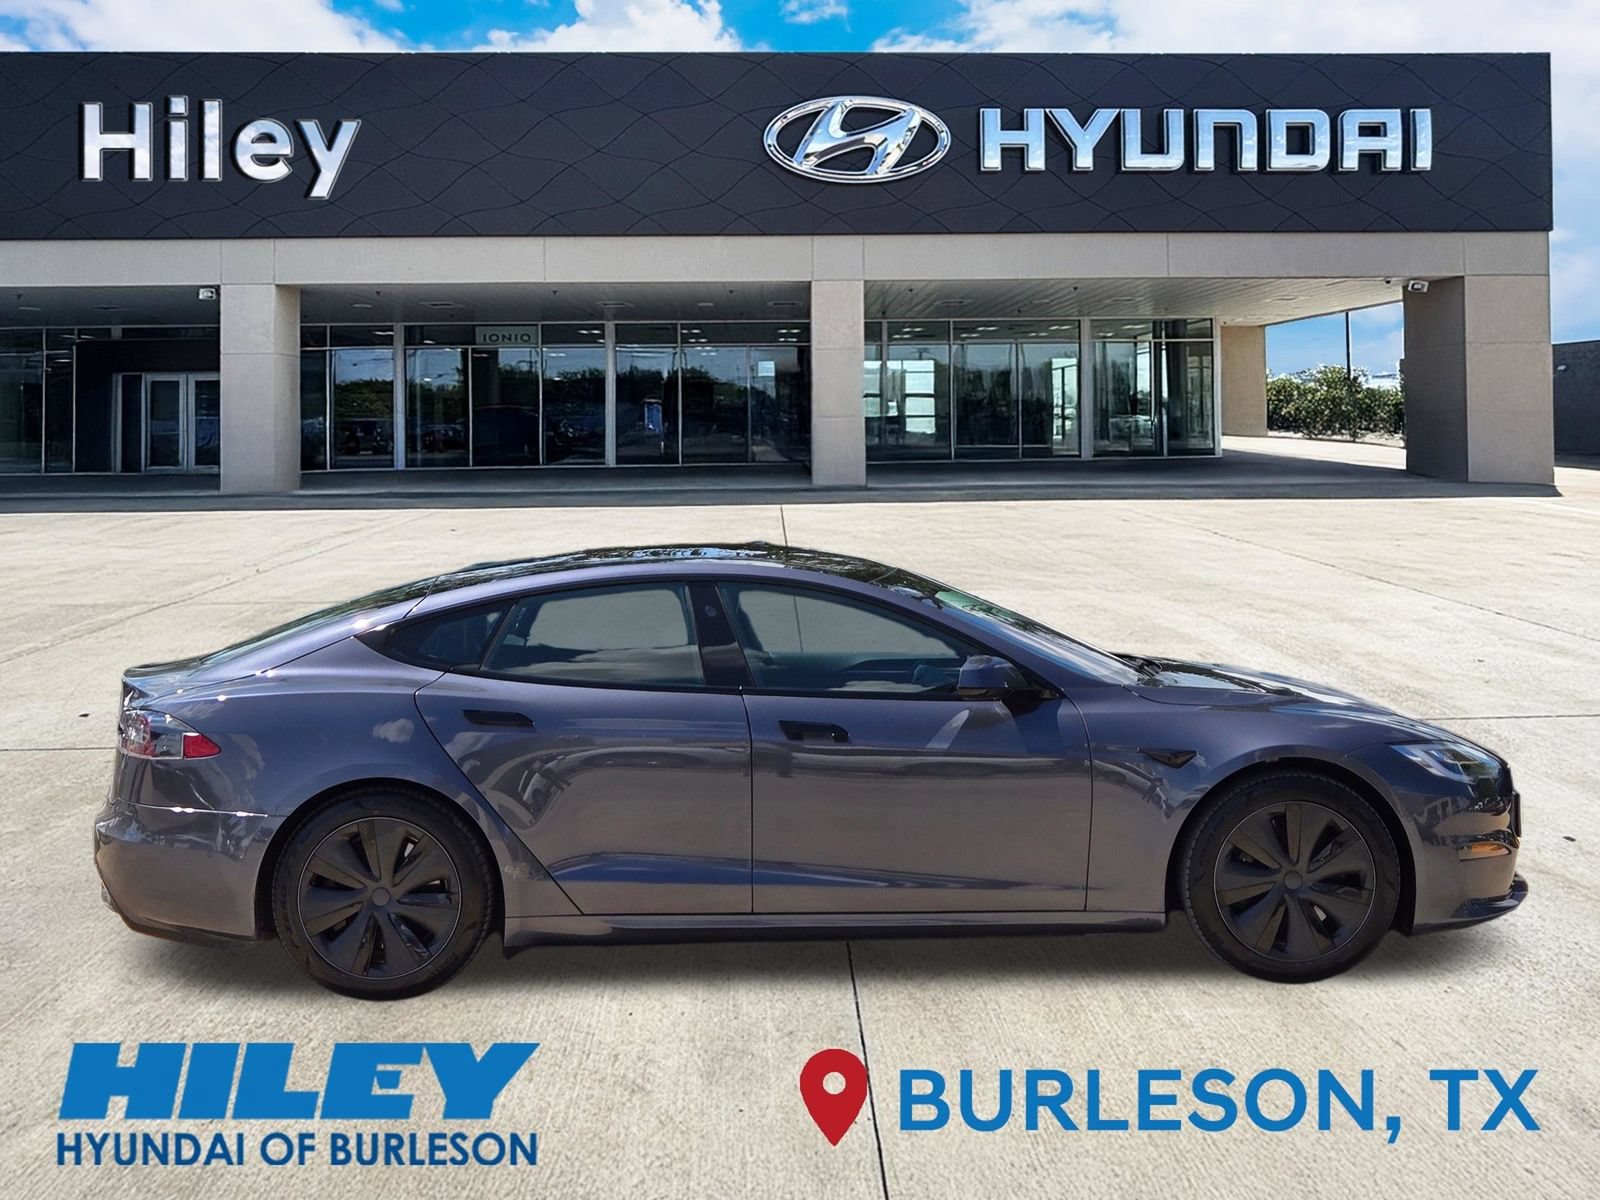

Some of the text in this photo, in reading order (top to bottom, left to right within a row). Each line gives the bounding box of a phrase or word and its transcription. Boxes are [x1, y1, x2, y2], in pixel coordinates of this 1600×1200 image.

[81, 95, 361, 199] Hiley
[980, 108, 1432, 171] HYUNDAI
[483, 333, 531, 343] IONIQ
